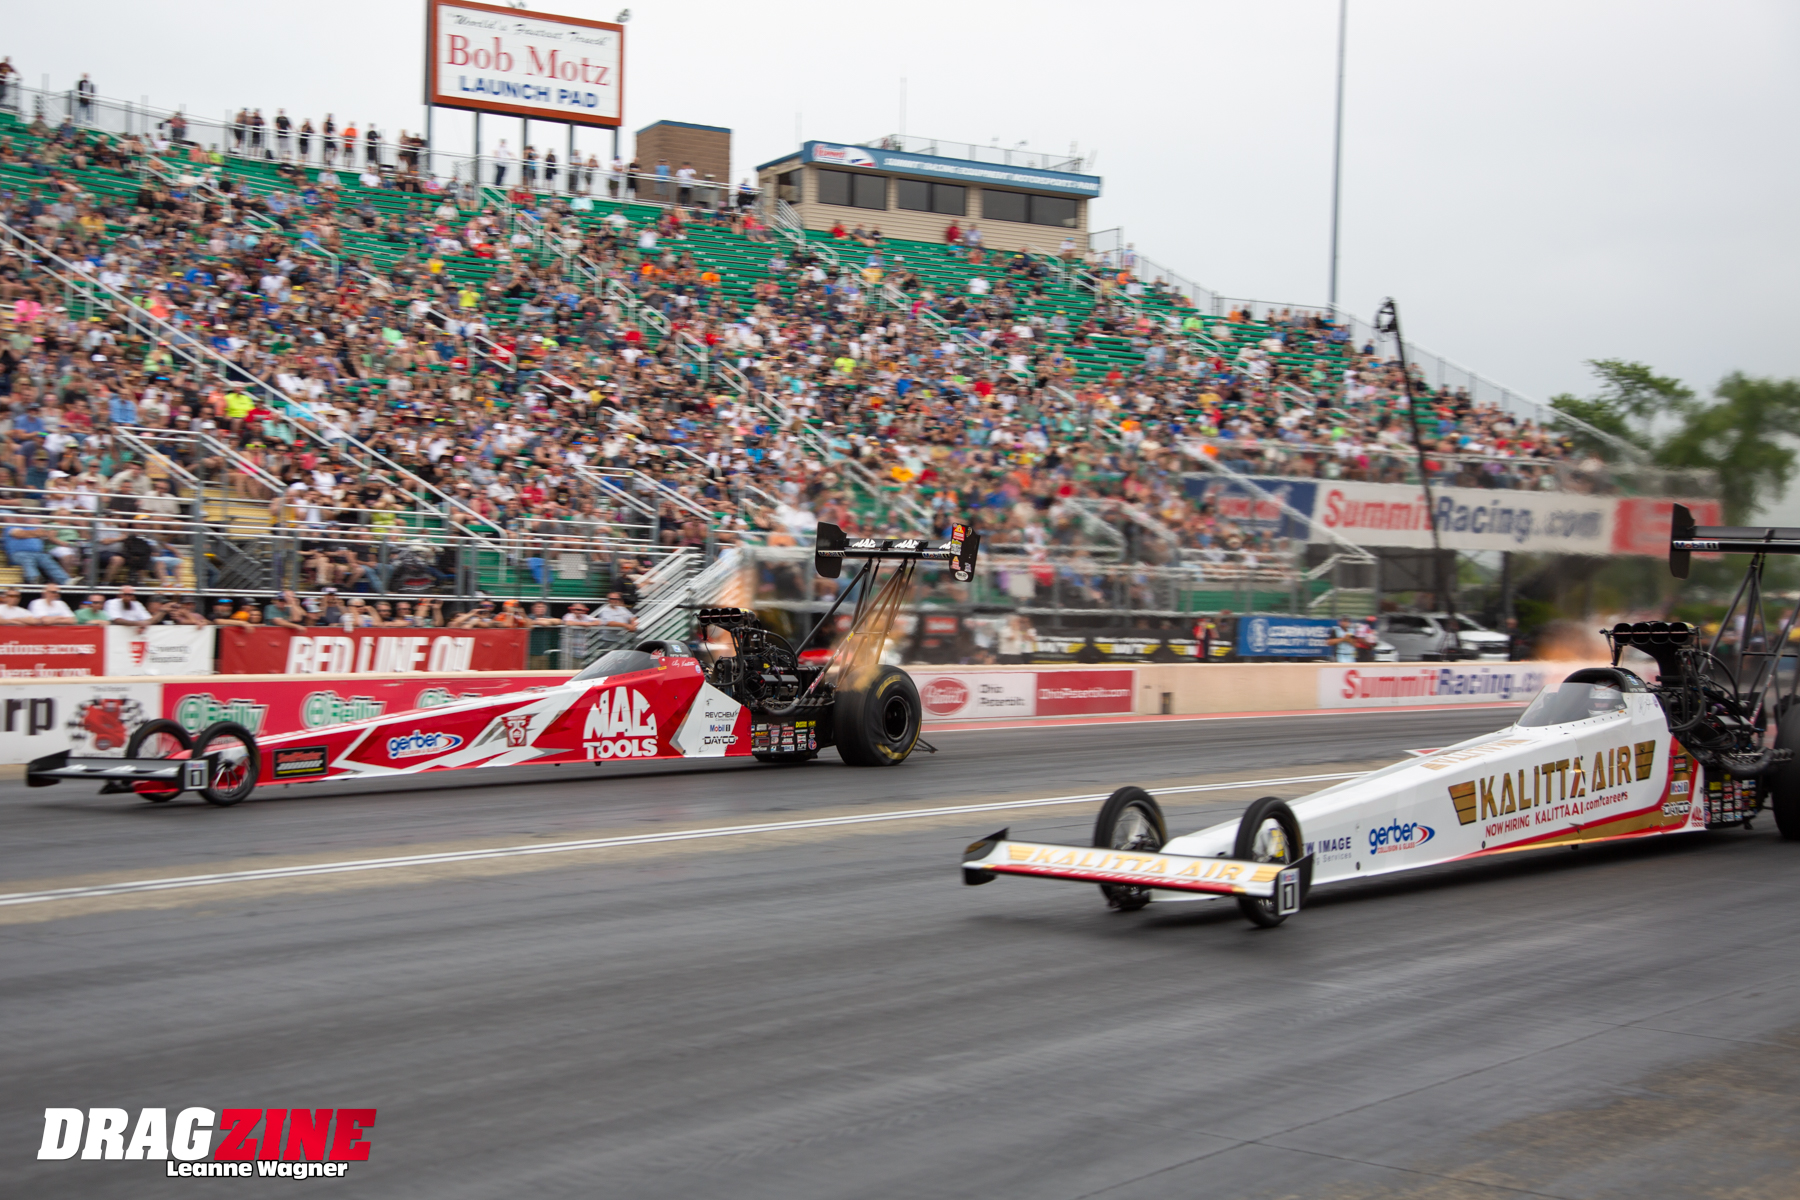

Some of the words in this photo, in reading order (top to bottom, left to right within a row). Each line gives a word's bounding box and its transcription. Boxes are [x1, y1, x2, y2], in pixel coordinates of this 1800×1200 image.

[445, 34, 514, 72] Bob
[525, 45, 612, 86] Motz
[459, 75, 550, 101] LAUNCH
[557, 89, 600, 108] PAD
[1675, 541, 1705, 549] Mobil
[286, 636, 354, 674] RED
[357, 636, 428, 674] LINE
[428, 636, 475, 674] OIL
[583, 686, 658, 739] MAC
[388, 730, 441, 758] gerber
[583, 738, 658, 760] TOOLS
[703, 736, 738, 744] DAYCO
[1480, 757, 1586, 821] KALITTA
[1591, 745, 1632, 792] AIR
[1369, 818, 1417, 855] gerber
[1485, 821, 1504, 838] NOW
[1505, 814, 1530, 834] HIRING
[1318, 836, 1352, 854] IMAGE
[1029, 847, 1166, 874] KALITTA
[1176, 861, 1245, 881] AIR
